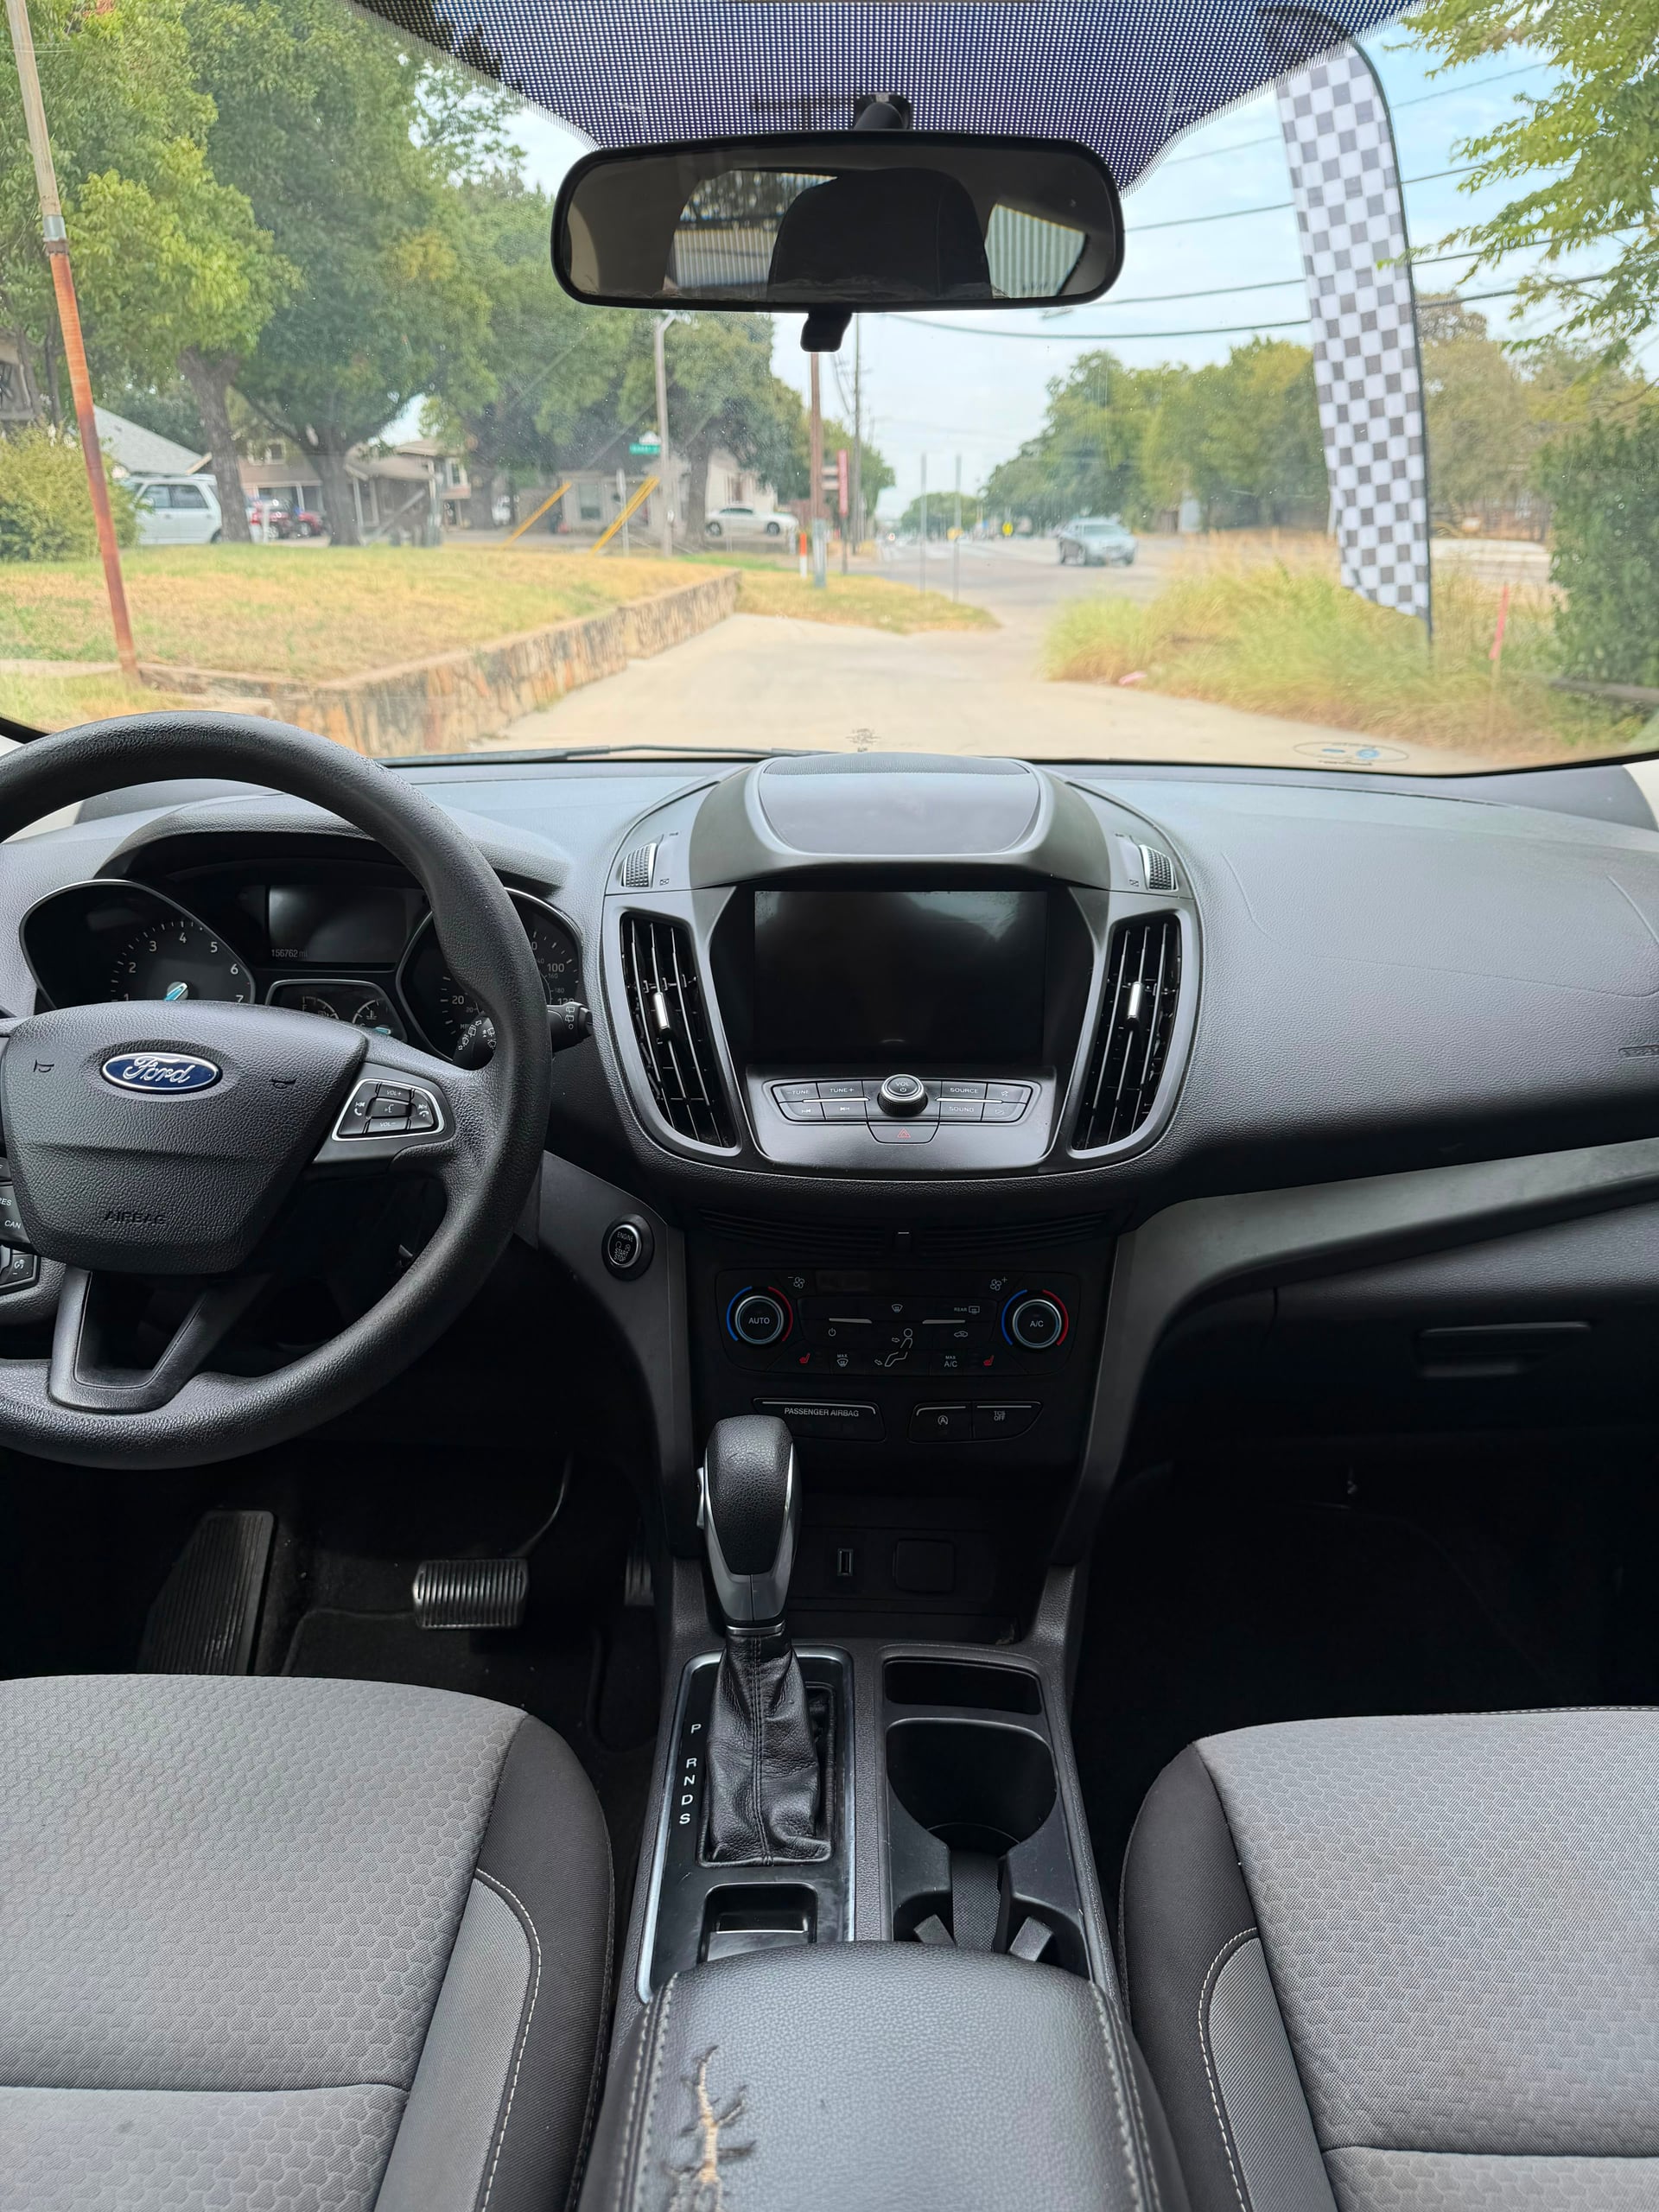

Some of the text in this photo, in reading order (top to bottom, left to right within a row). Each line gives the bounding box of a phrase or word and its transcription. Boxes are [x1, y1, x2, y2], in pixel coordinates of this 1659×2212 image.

[179, 932, 187, 944] 4
[149, 940, 157, 952] 3
[210, 941, 218, 953] 5
[271, 949, 298, 958] 156762
[129, 962, 137, 974] 2
[230, 963, 239, 975] 6
[547, 963, 565, 973] 100
[451, 995, 465, 1006] 20
[122, 1055, 195, 1084] Ford
[4, 1219, 22, 1230] CAN
[1029, 1319, 1044, 1328] A/C
[784, 1408, 830, 1416] PASSENGER
[691, 1723, 702, 1734] P
[686, 1758, 697, 1769] R
[683, 1774, 696, 1786] N
[681, 1794, 694, 1806] D
[679, 1813, 690, 1825] S
